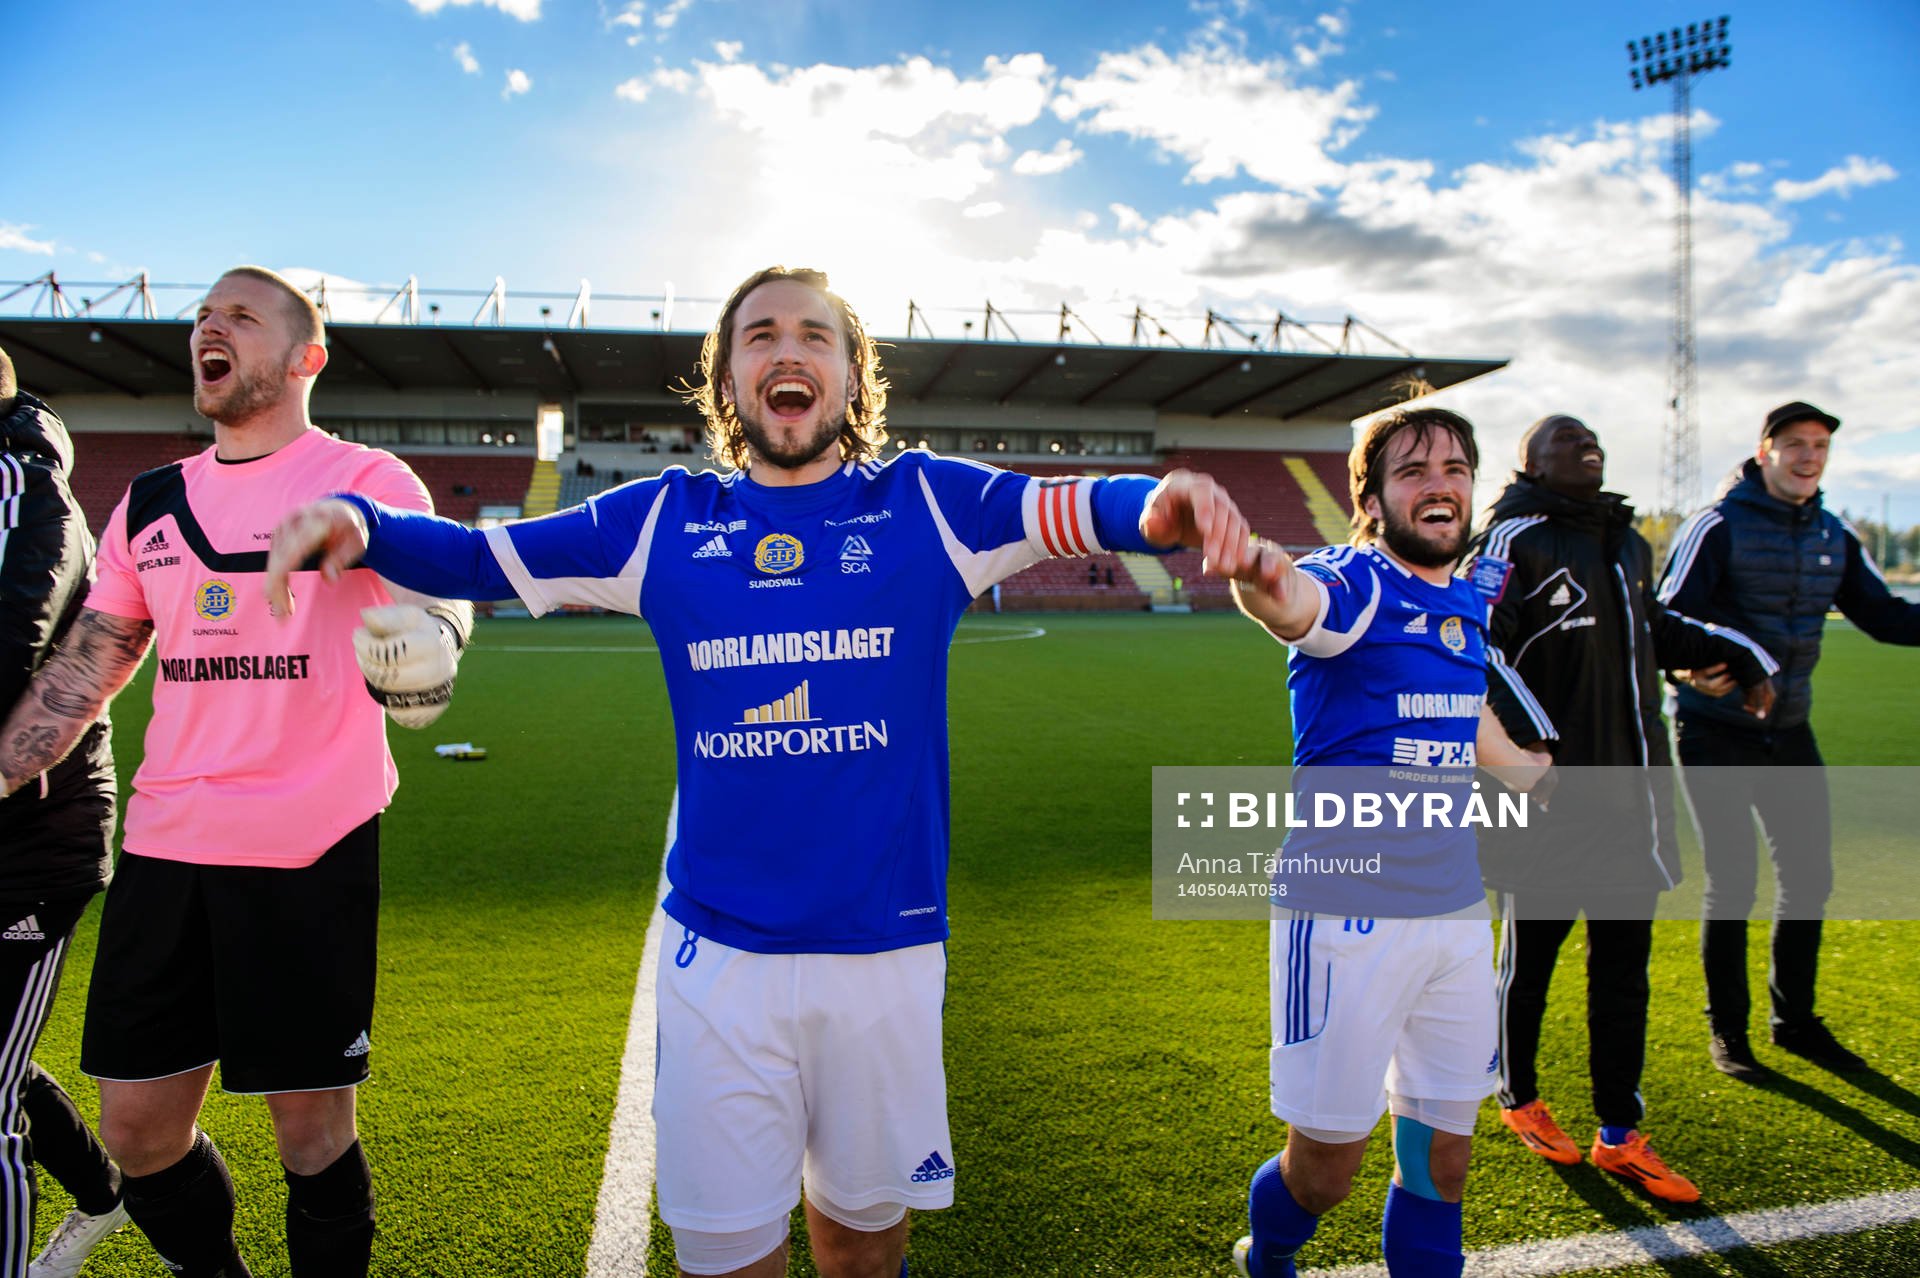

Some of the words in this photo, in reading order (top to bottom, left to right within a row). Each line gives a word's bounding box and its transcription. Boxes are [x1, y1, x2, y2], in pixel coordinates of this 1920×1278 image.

[692, 549, 733, 558] adidas
[138, 556, 176, 572] PEAB
[841, 562, 871, 574] SCA
[749, 577, 804, 588] SUNDSVALL
[192, 628, 239, 636] SUNDSVALL
[687, 627, 895, 671] NORRLANDSLAGET
[694, 719, 889, 758] NORRPORTEN
[1388, 769, 1440, 784] NORDENS
[2, 930, 46, 940] adidas
[675, 927, 699, 968] 8
[911, 1168, 954, 1182] adidas
